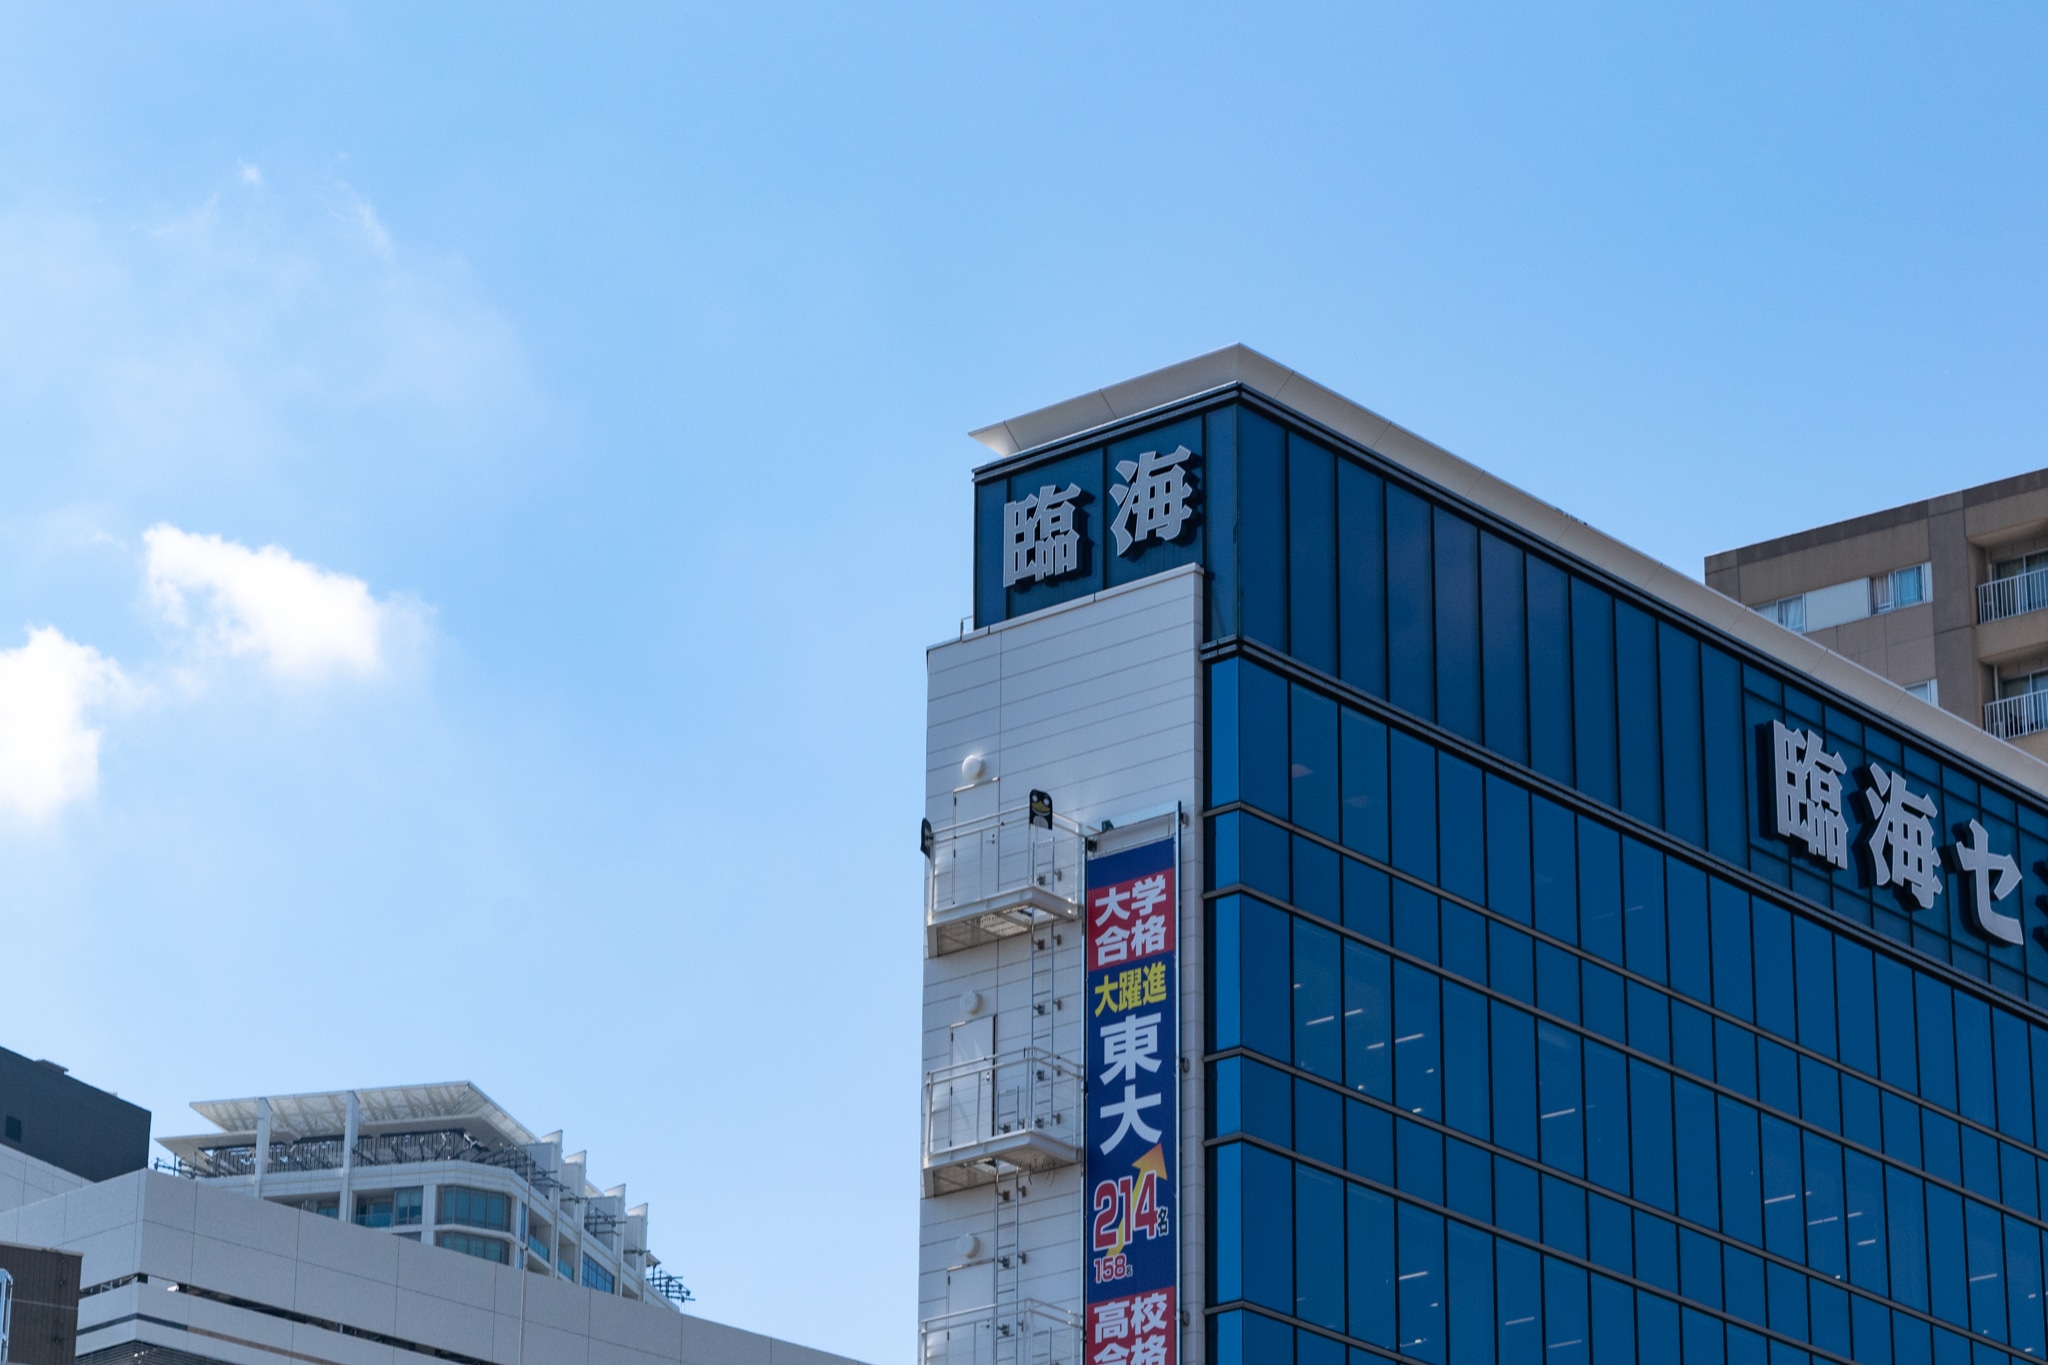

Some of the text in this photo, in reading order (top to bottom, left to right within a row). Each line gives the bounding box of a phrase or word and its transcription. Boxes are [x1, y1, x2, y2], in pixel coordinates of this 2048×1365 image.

[1003, 445, 1193, 588] 臨海
[1773, 719, 2024, 945] 臨海セ
[1095, 874, 1166, 927] 大学
[1095, 915, 1166, 966] 合格
[1094, 961, 1167, 1018] 大躍進
[1099, 1012, 1162, 1156] 東大
[1093, 1170, 1168, 1252] 214名
[1094, 1292, 1167, 1344] 高校
